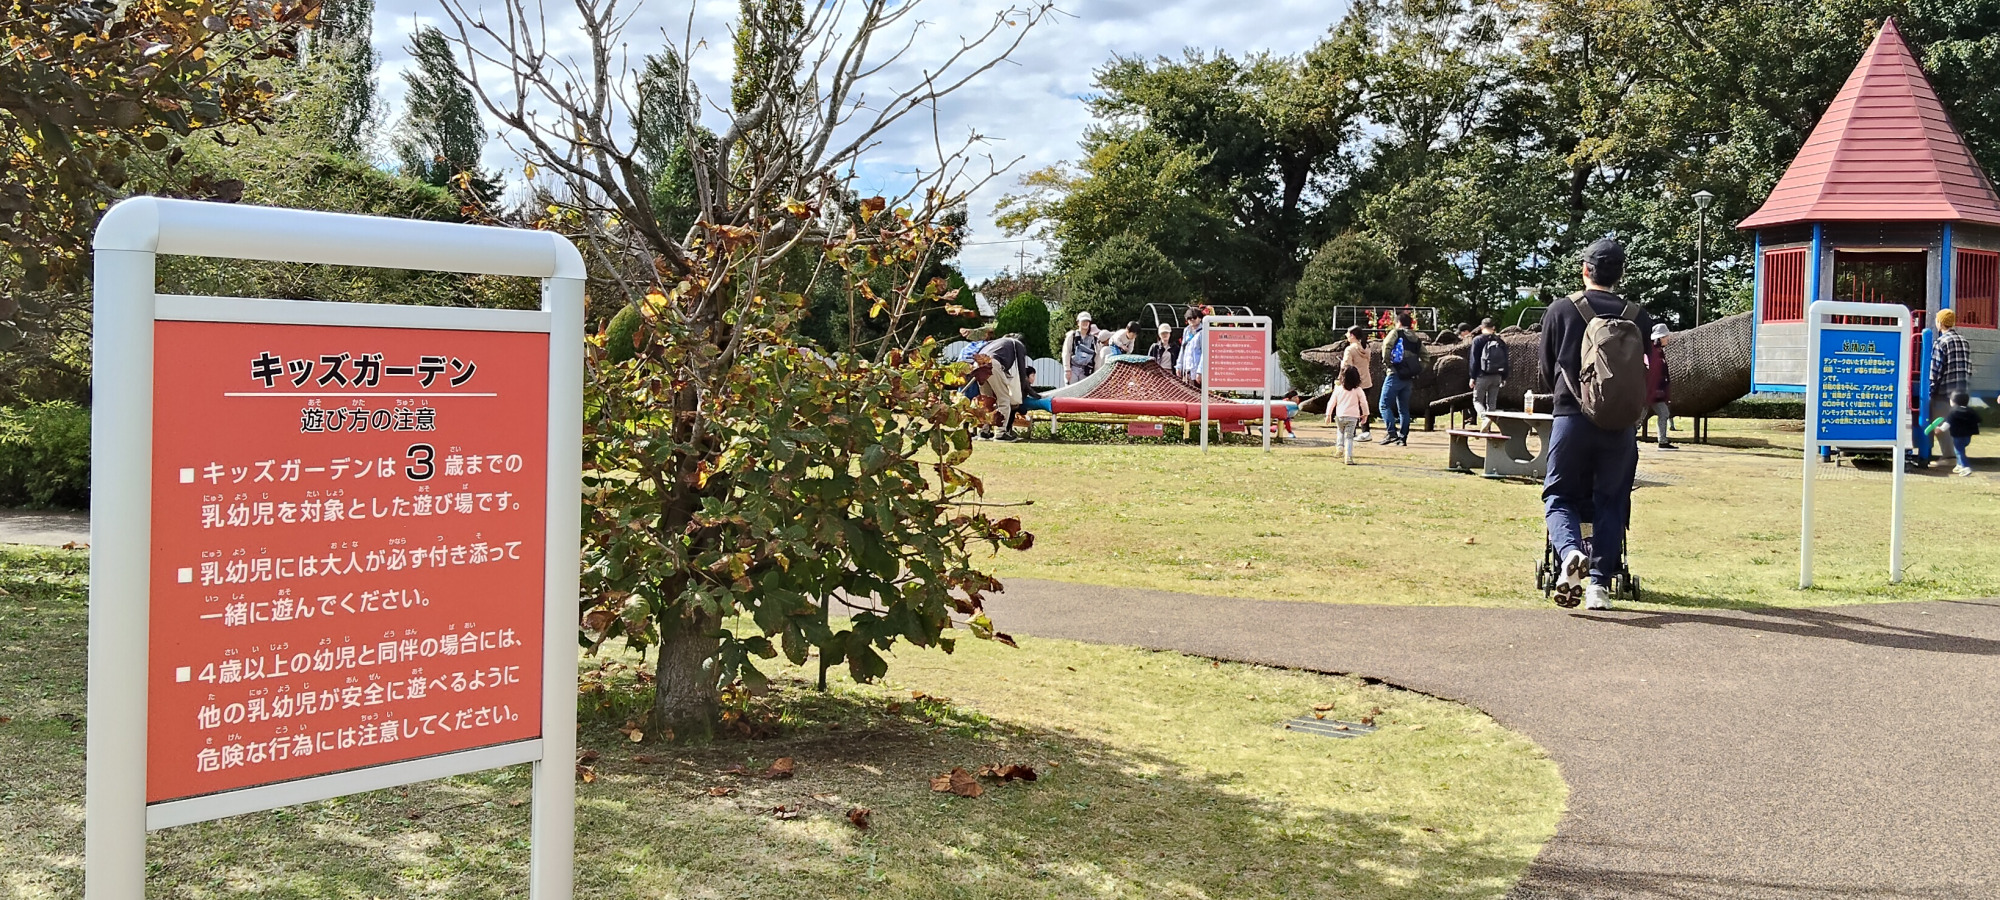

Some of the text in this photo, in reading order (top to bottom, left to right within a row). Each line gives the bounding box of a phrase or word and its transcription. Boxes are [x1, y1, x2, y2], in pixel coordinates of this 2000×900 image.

[251, 350, 477, 389] キッズガーデン
[301, 407, 436, 433] 遊び方の注意
[201, 492, 520, 528] 乳幼児を対象とした遊び場です。
[200, 540, 522, 586] 乳幼児には大人が必ず付き添って
[200, 589, 430, 627] 一緒に遊んでください。
[198, 627, 523, 685] 4歳以上の幼児と同伴の場合には、
[198, 665, 519, 731] 他の乳幼児が安全に遊べるように
[197, 704, 519, 773] 危険な行為には注意してください。
